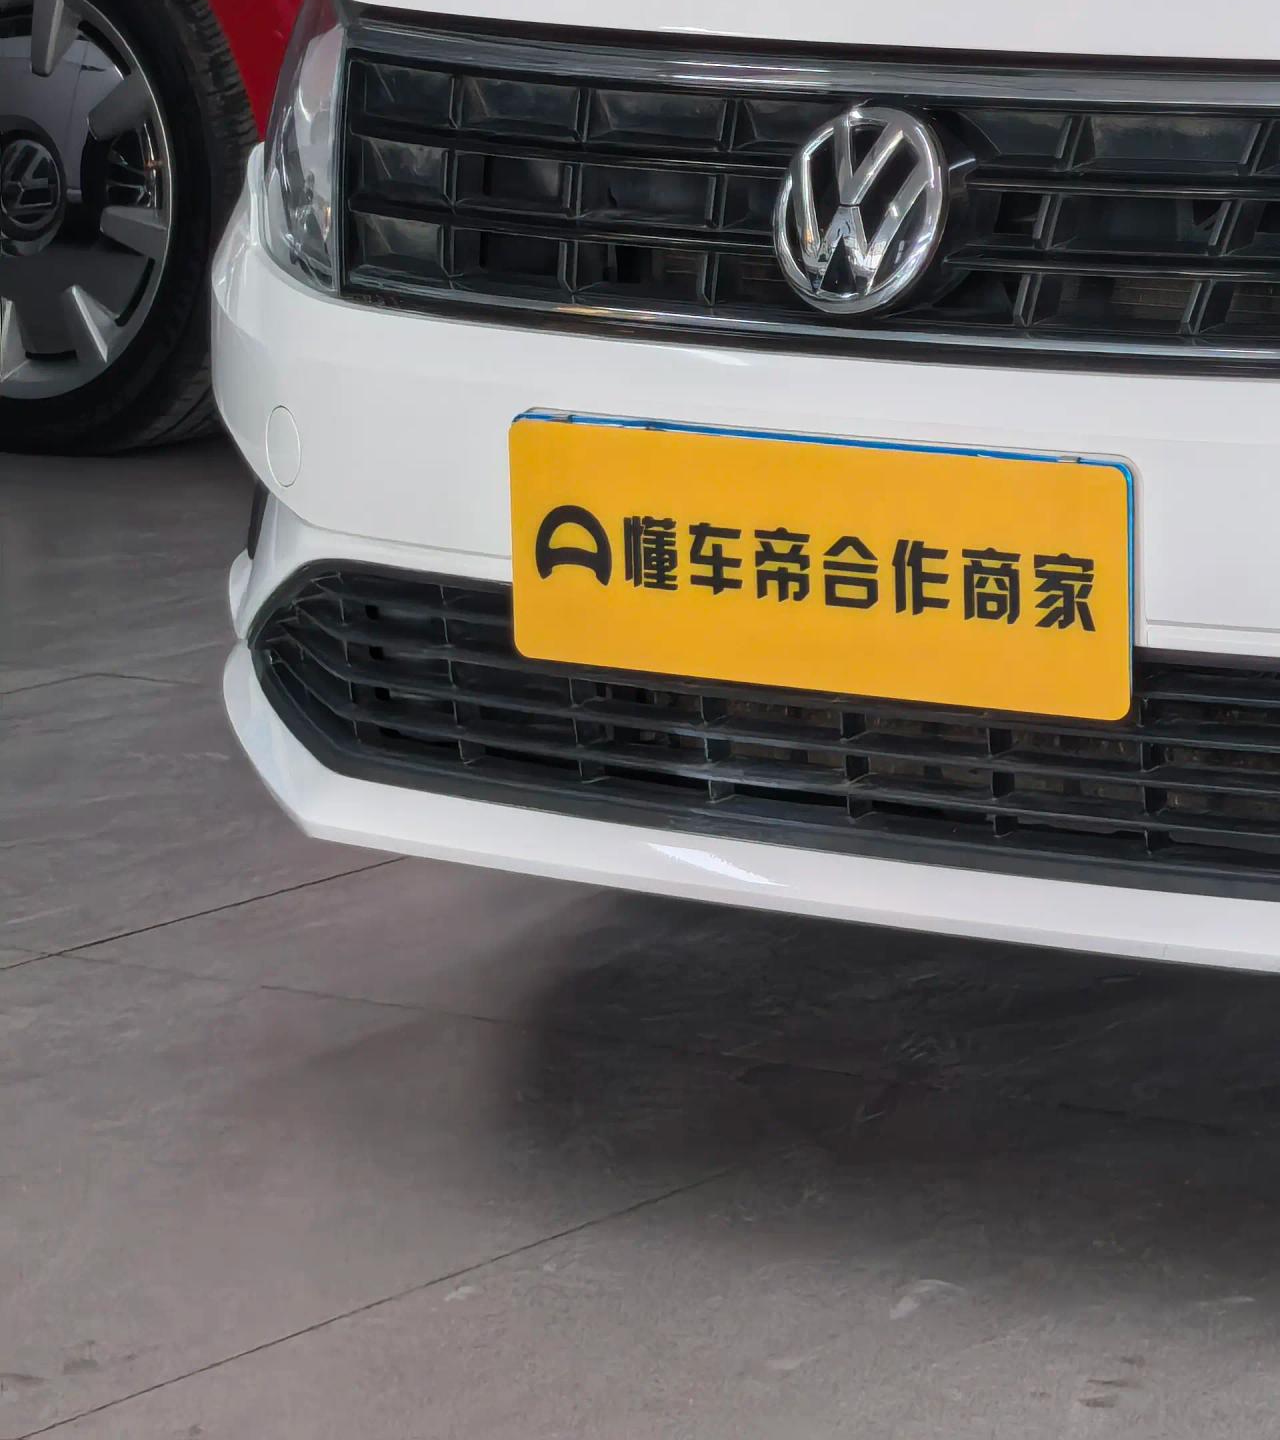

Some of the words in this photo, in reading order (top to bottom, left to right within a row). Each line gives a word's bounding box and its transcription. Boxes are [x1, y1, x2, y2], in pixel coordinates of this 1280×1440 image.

[623, 515, 1097, 633] 懂车帝合作商家
